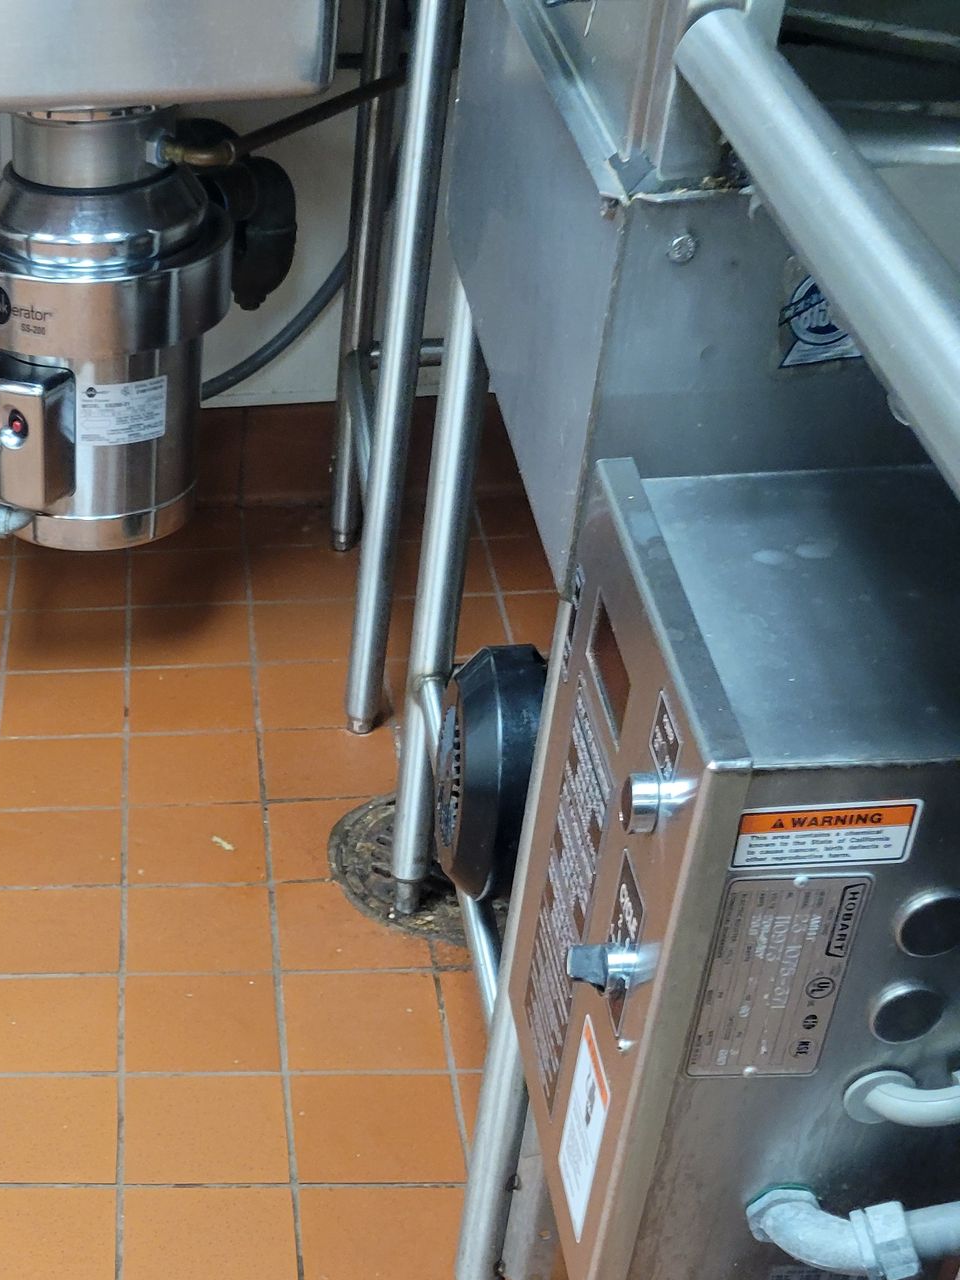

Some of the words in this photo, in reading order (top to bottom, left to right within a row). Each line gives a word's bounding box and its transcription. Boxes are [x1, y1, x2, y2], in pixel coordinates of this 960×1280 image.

[791, 812, 883, 829] WARNING
[771, 854, 823, 862] reproductive
[834, 891, 861, 951] HOBART
[810, 981, 831, 995] UL
